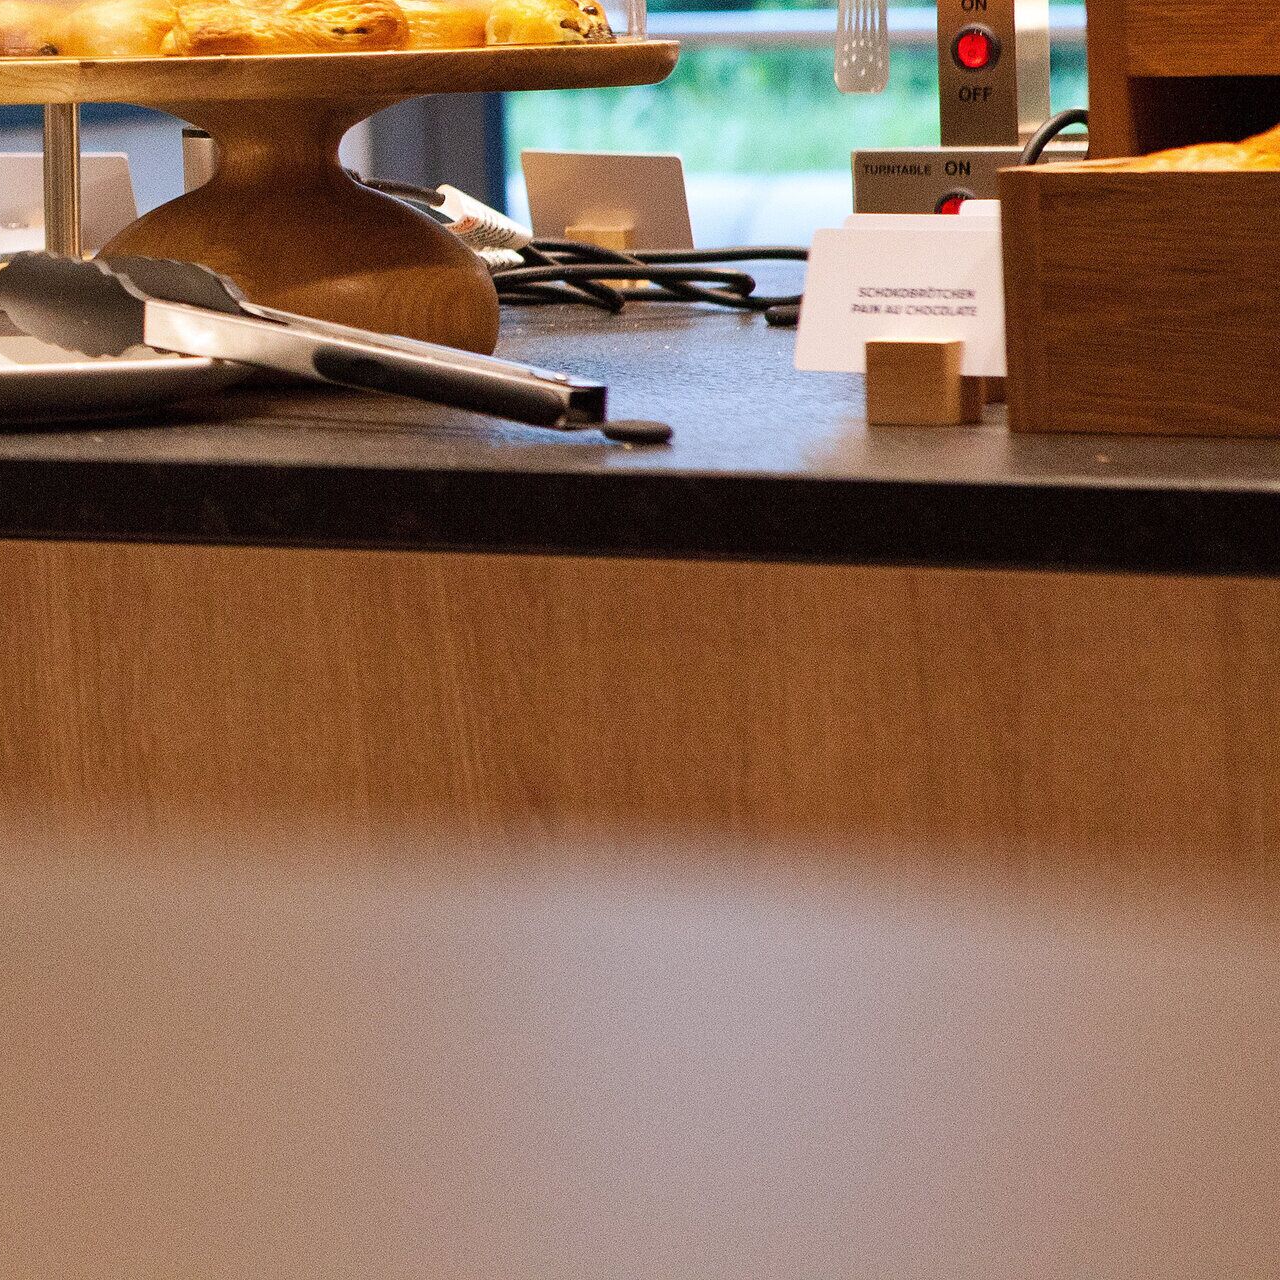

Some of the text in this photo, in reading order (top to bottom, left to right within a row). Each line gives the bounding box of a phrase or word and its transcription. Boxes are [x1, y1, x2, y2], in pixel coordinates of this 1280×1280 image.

[958, 87, 992, 103] OFF
[863, 160, 971, 176] TURNTABLE ON
[852, 303, 881, 314] PAIN
[885, 304, 903, 315] AU
